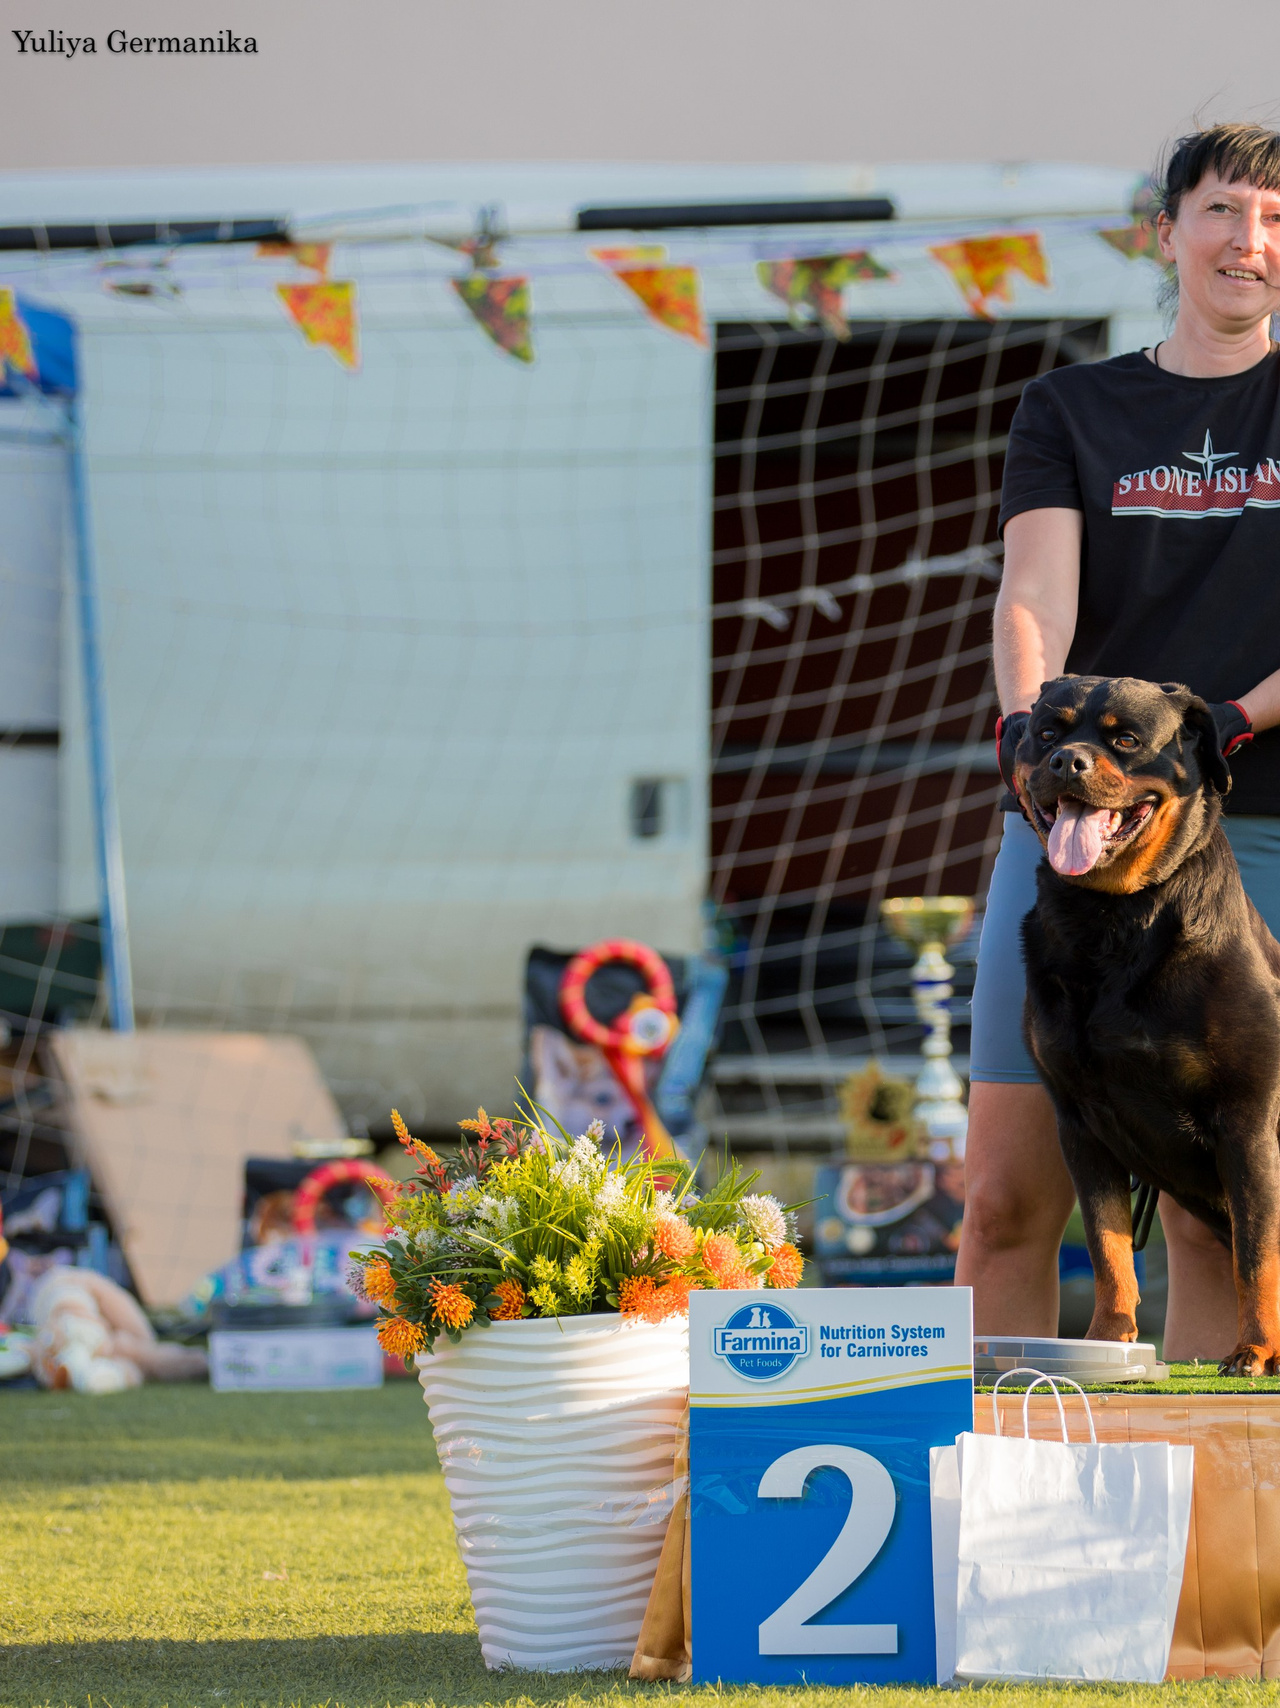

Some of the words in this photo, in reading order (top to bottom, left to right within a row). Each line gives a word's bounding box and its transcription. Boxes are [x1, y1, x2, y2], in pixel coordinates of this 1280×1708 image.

[1118, 465, 1203, 497] STONE
[720, 1330, 802, 1352] Farmina
[819, 1325, 886, 1340] Nutrition
[890, 1324, 946, 1343] System
[820, 1343, 842, 1358] for
[846, 1343, 929, 1358] Carnivores
[739, 1358, 756, 1368] Pet
[756, 1358, 783, 1368] Foods
[757, 1444, 898, 1655] 2
